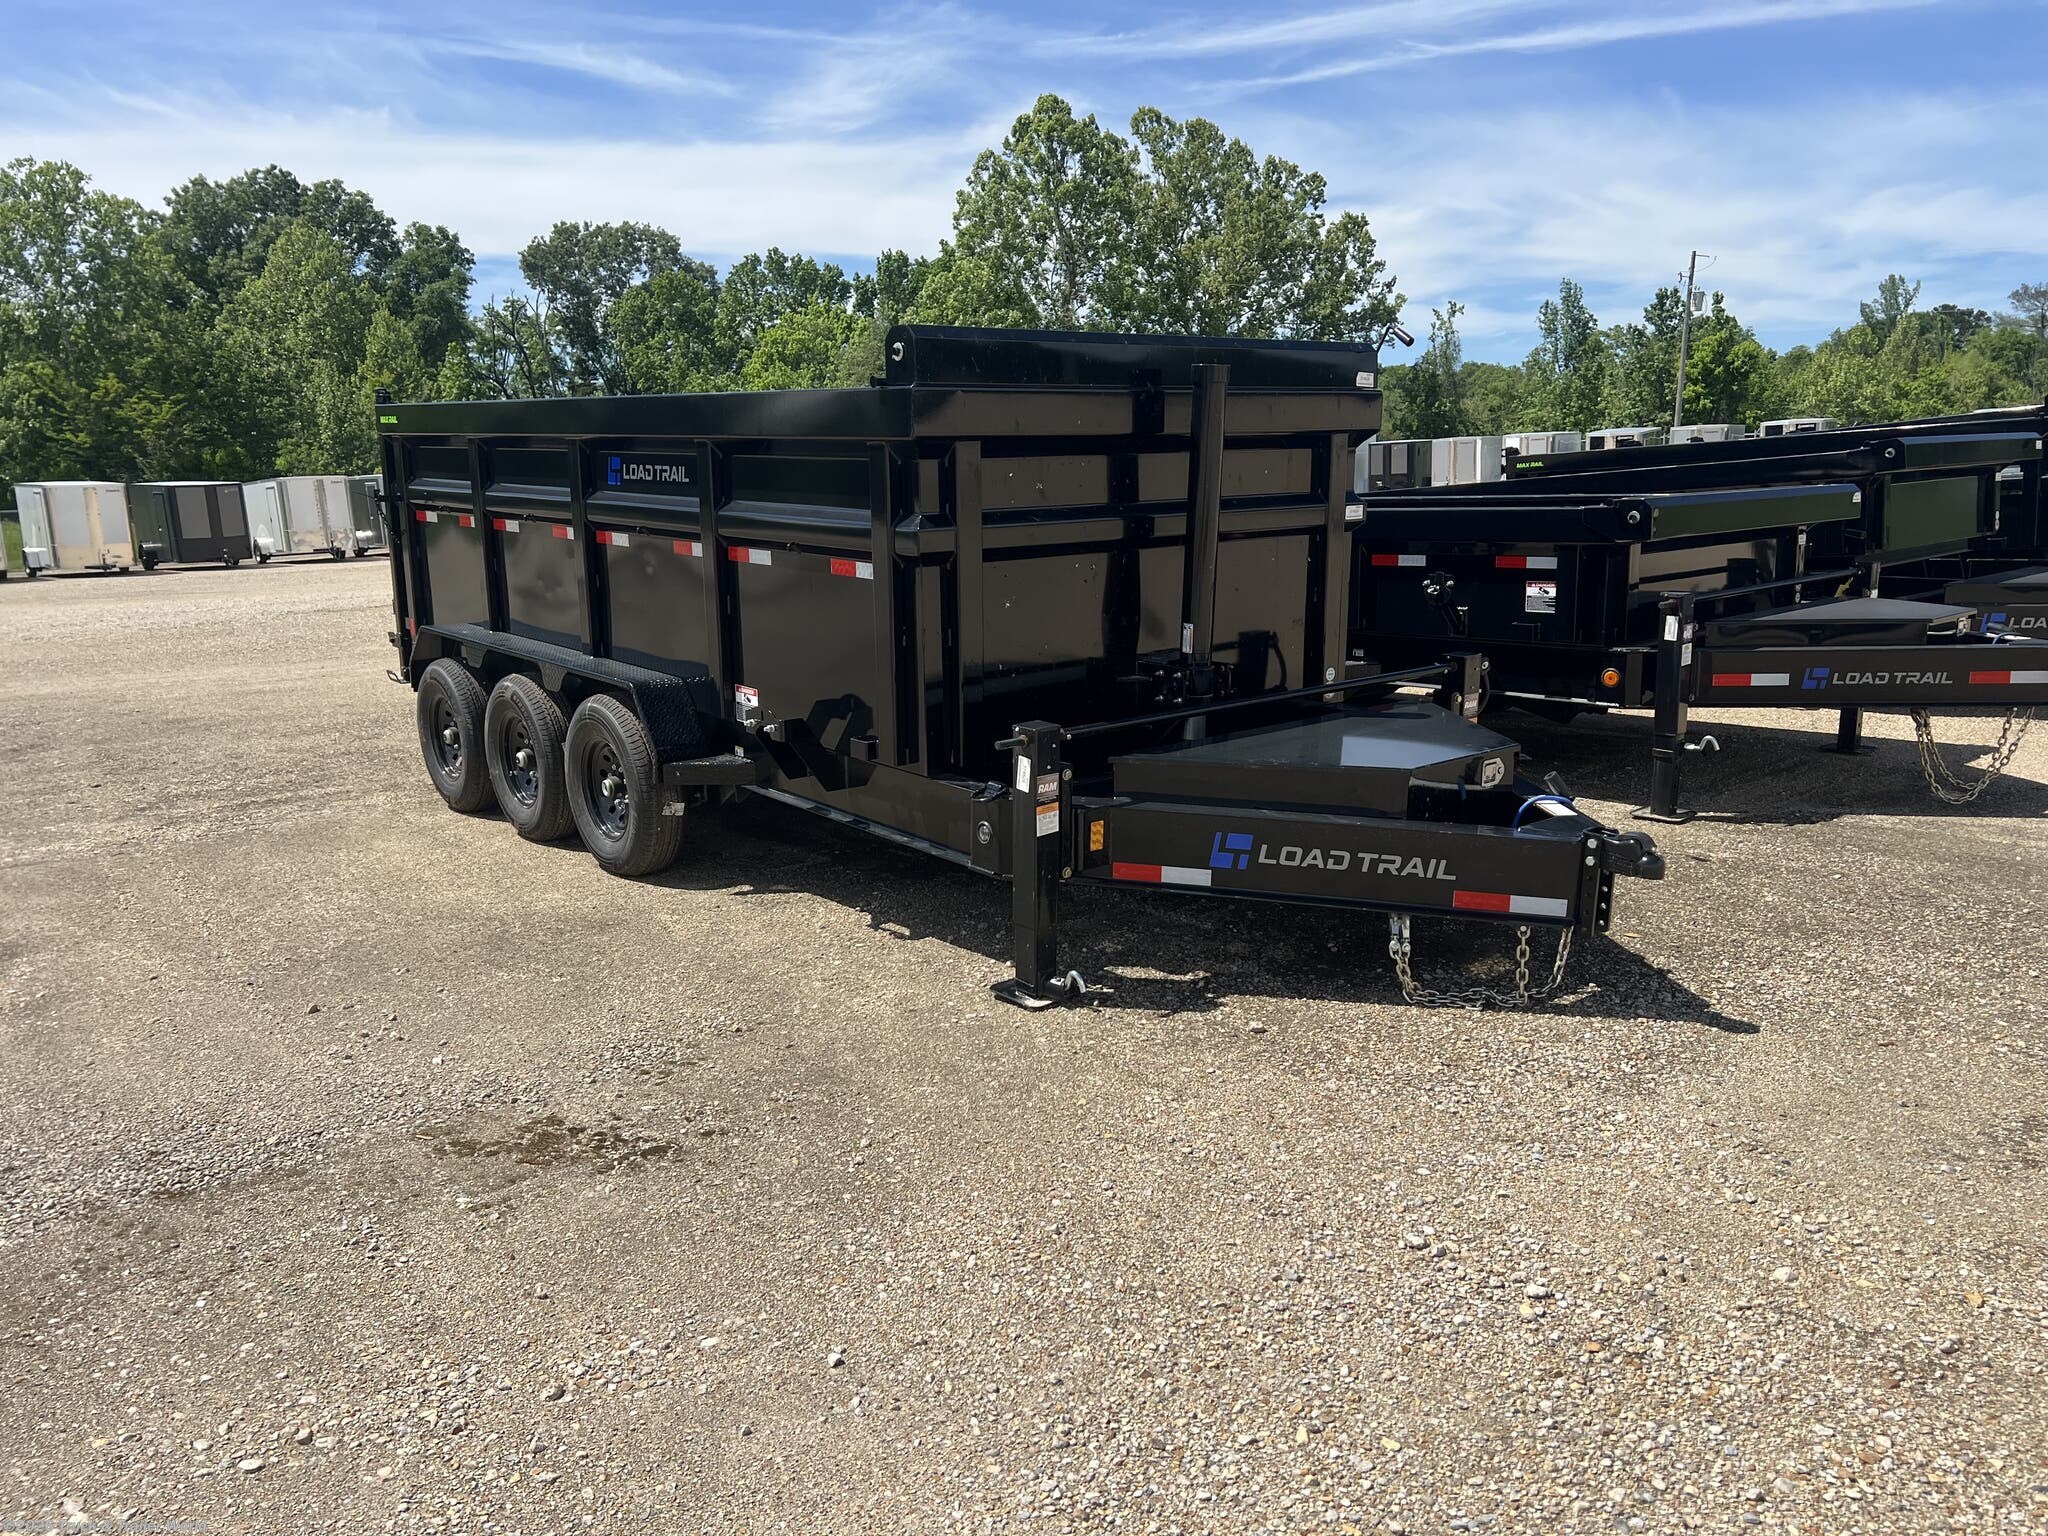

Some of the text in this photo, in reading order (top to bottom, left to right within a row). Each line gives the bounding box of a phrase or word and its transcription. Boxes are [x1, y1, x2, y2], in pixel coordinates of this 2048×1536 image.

[622, 463, 690, 483] LOAD TRAIL
[1832, 671, 1953, 685] LOAD TRAIL
[1037, 781, 1058, 794] RAM
[1257, 844, 1457, 881] LOAD TRAIL
